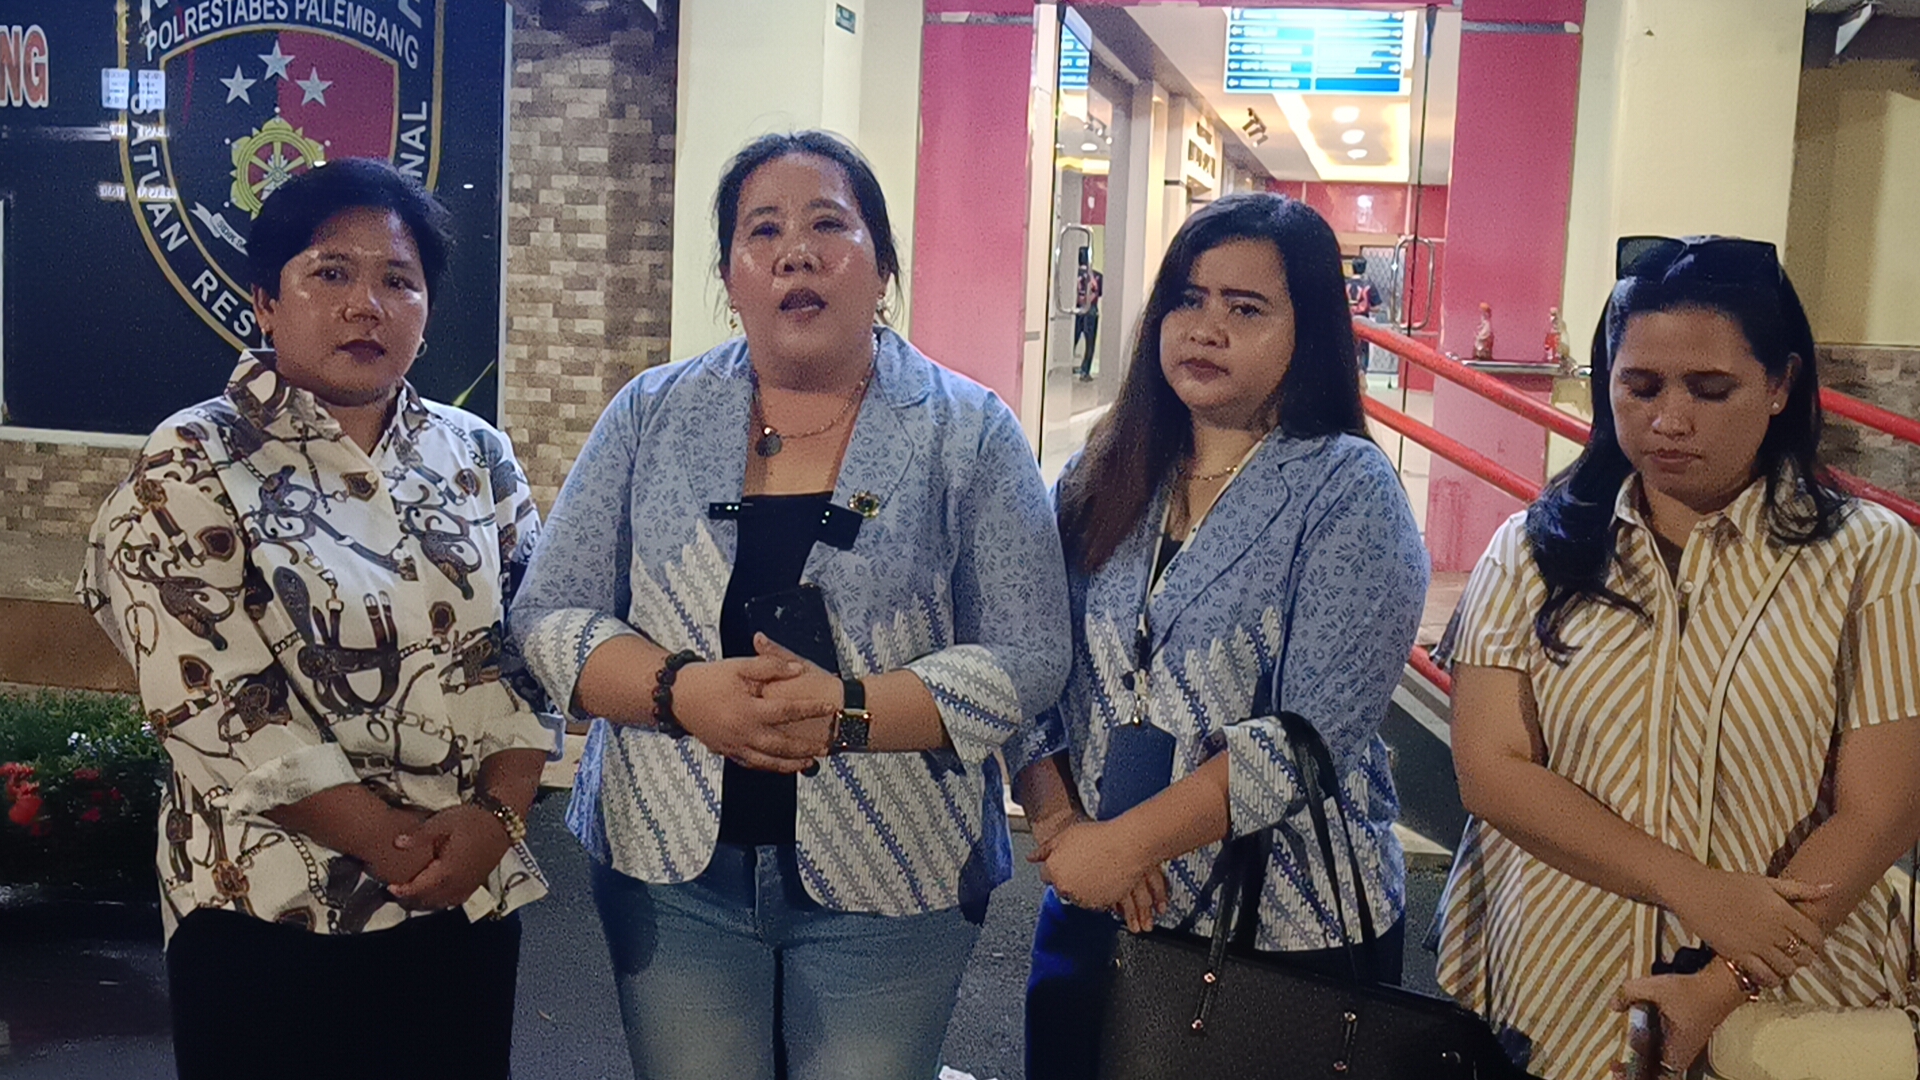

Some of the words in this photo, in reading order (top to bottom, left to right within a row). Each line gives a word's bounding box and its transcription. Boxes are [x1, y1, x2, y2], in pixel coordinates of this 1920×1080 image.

[145, 0, 288, 62] POLRESTABES
[295, 0, 419, 69] PALEMBANG
[129, 92, 189, 253] SATUAN
